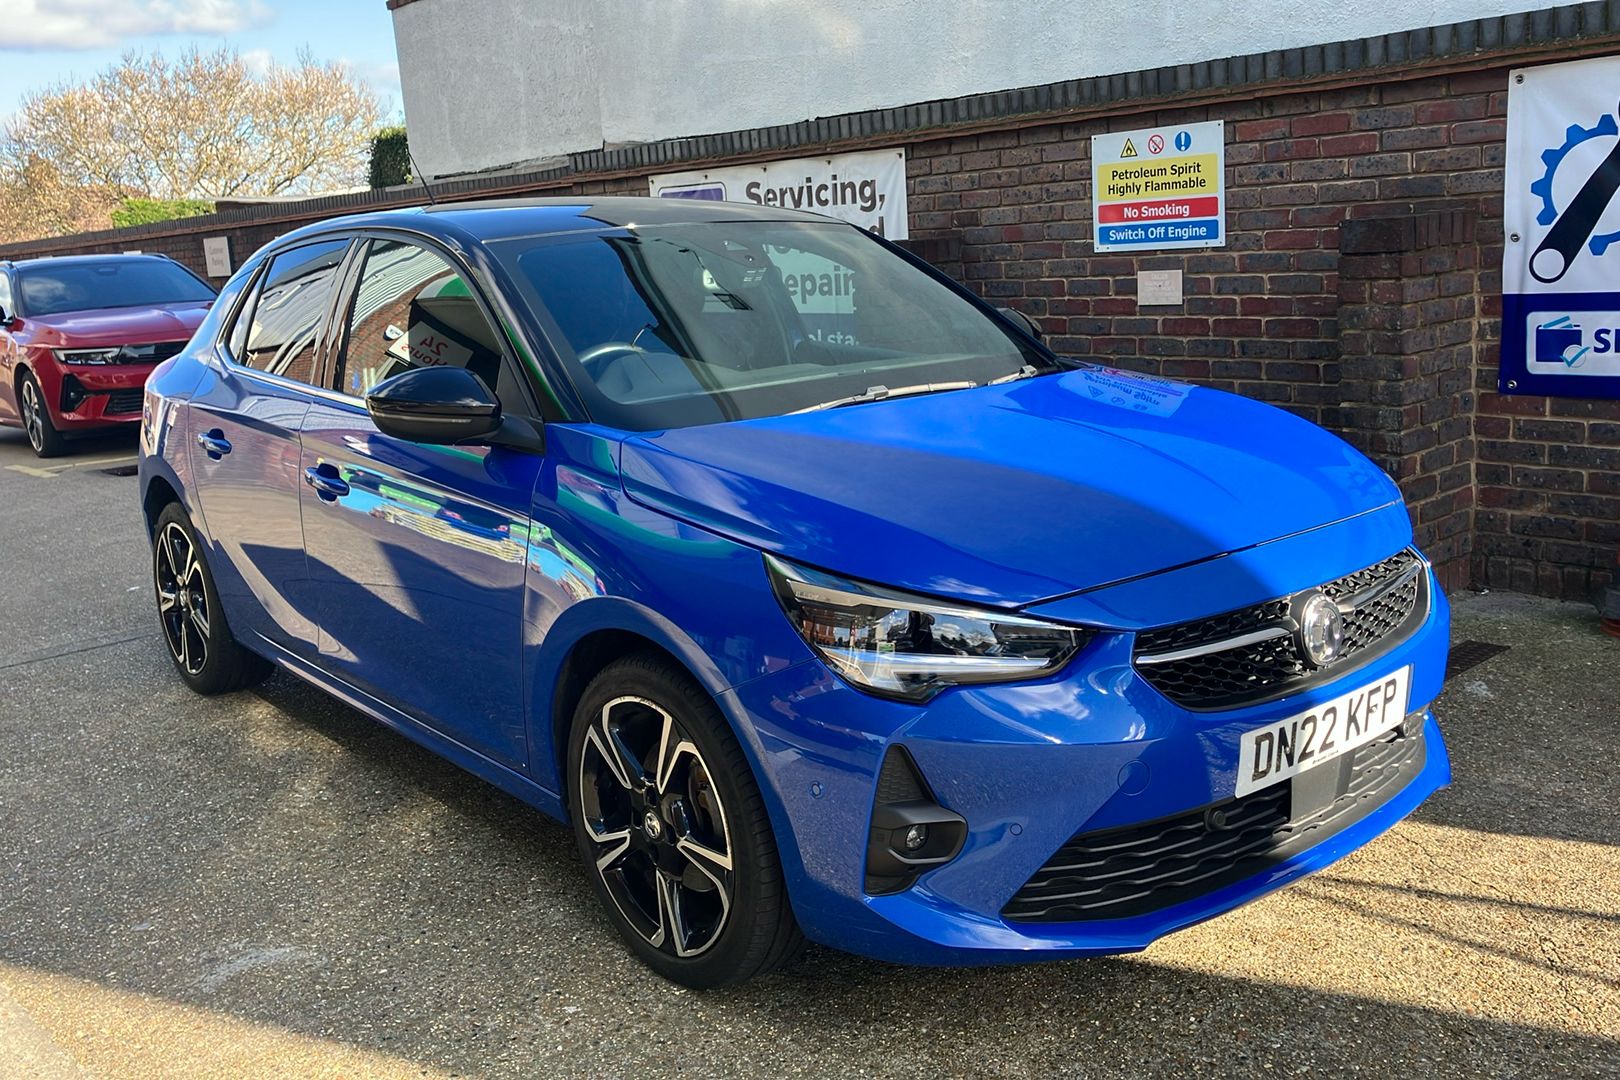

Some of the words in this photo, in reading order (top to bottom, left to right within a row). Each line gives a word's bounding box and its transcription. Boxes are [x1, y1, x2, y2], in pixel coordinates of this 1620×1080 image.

[1112, 166, 1167, 181] Petroleum
[1171, 162, 1202, 178] Spirit
[745, 174, 886, 212] Servicing,
[1108, 182, 1141, 197] Highly
[1145, 177, 1207, 192] Flammable
[1123, 207, 1139, 218] No
[1141, 203, 1190, 217] Smoking
[1109, 228, 1145, 241] Switch
[1148, 227, 1165, 239] Off
[1168, 225, 1207, 240] Engine
[785, 265, 852, 304] epair
[1251, 706, 1338, 782] DN22
[1345, 678, 1397, 741] KFP
